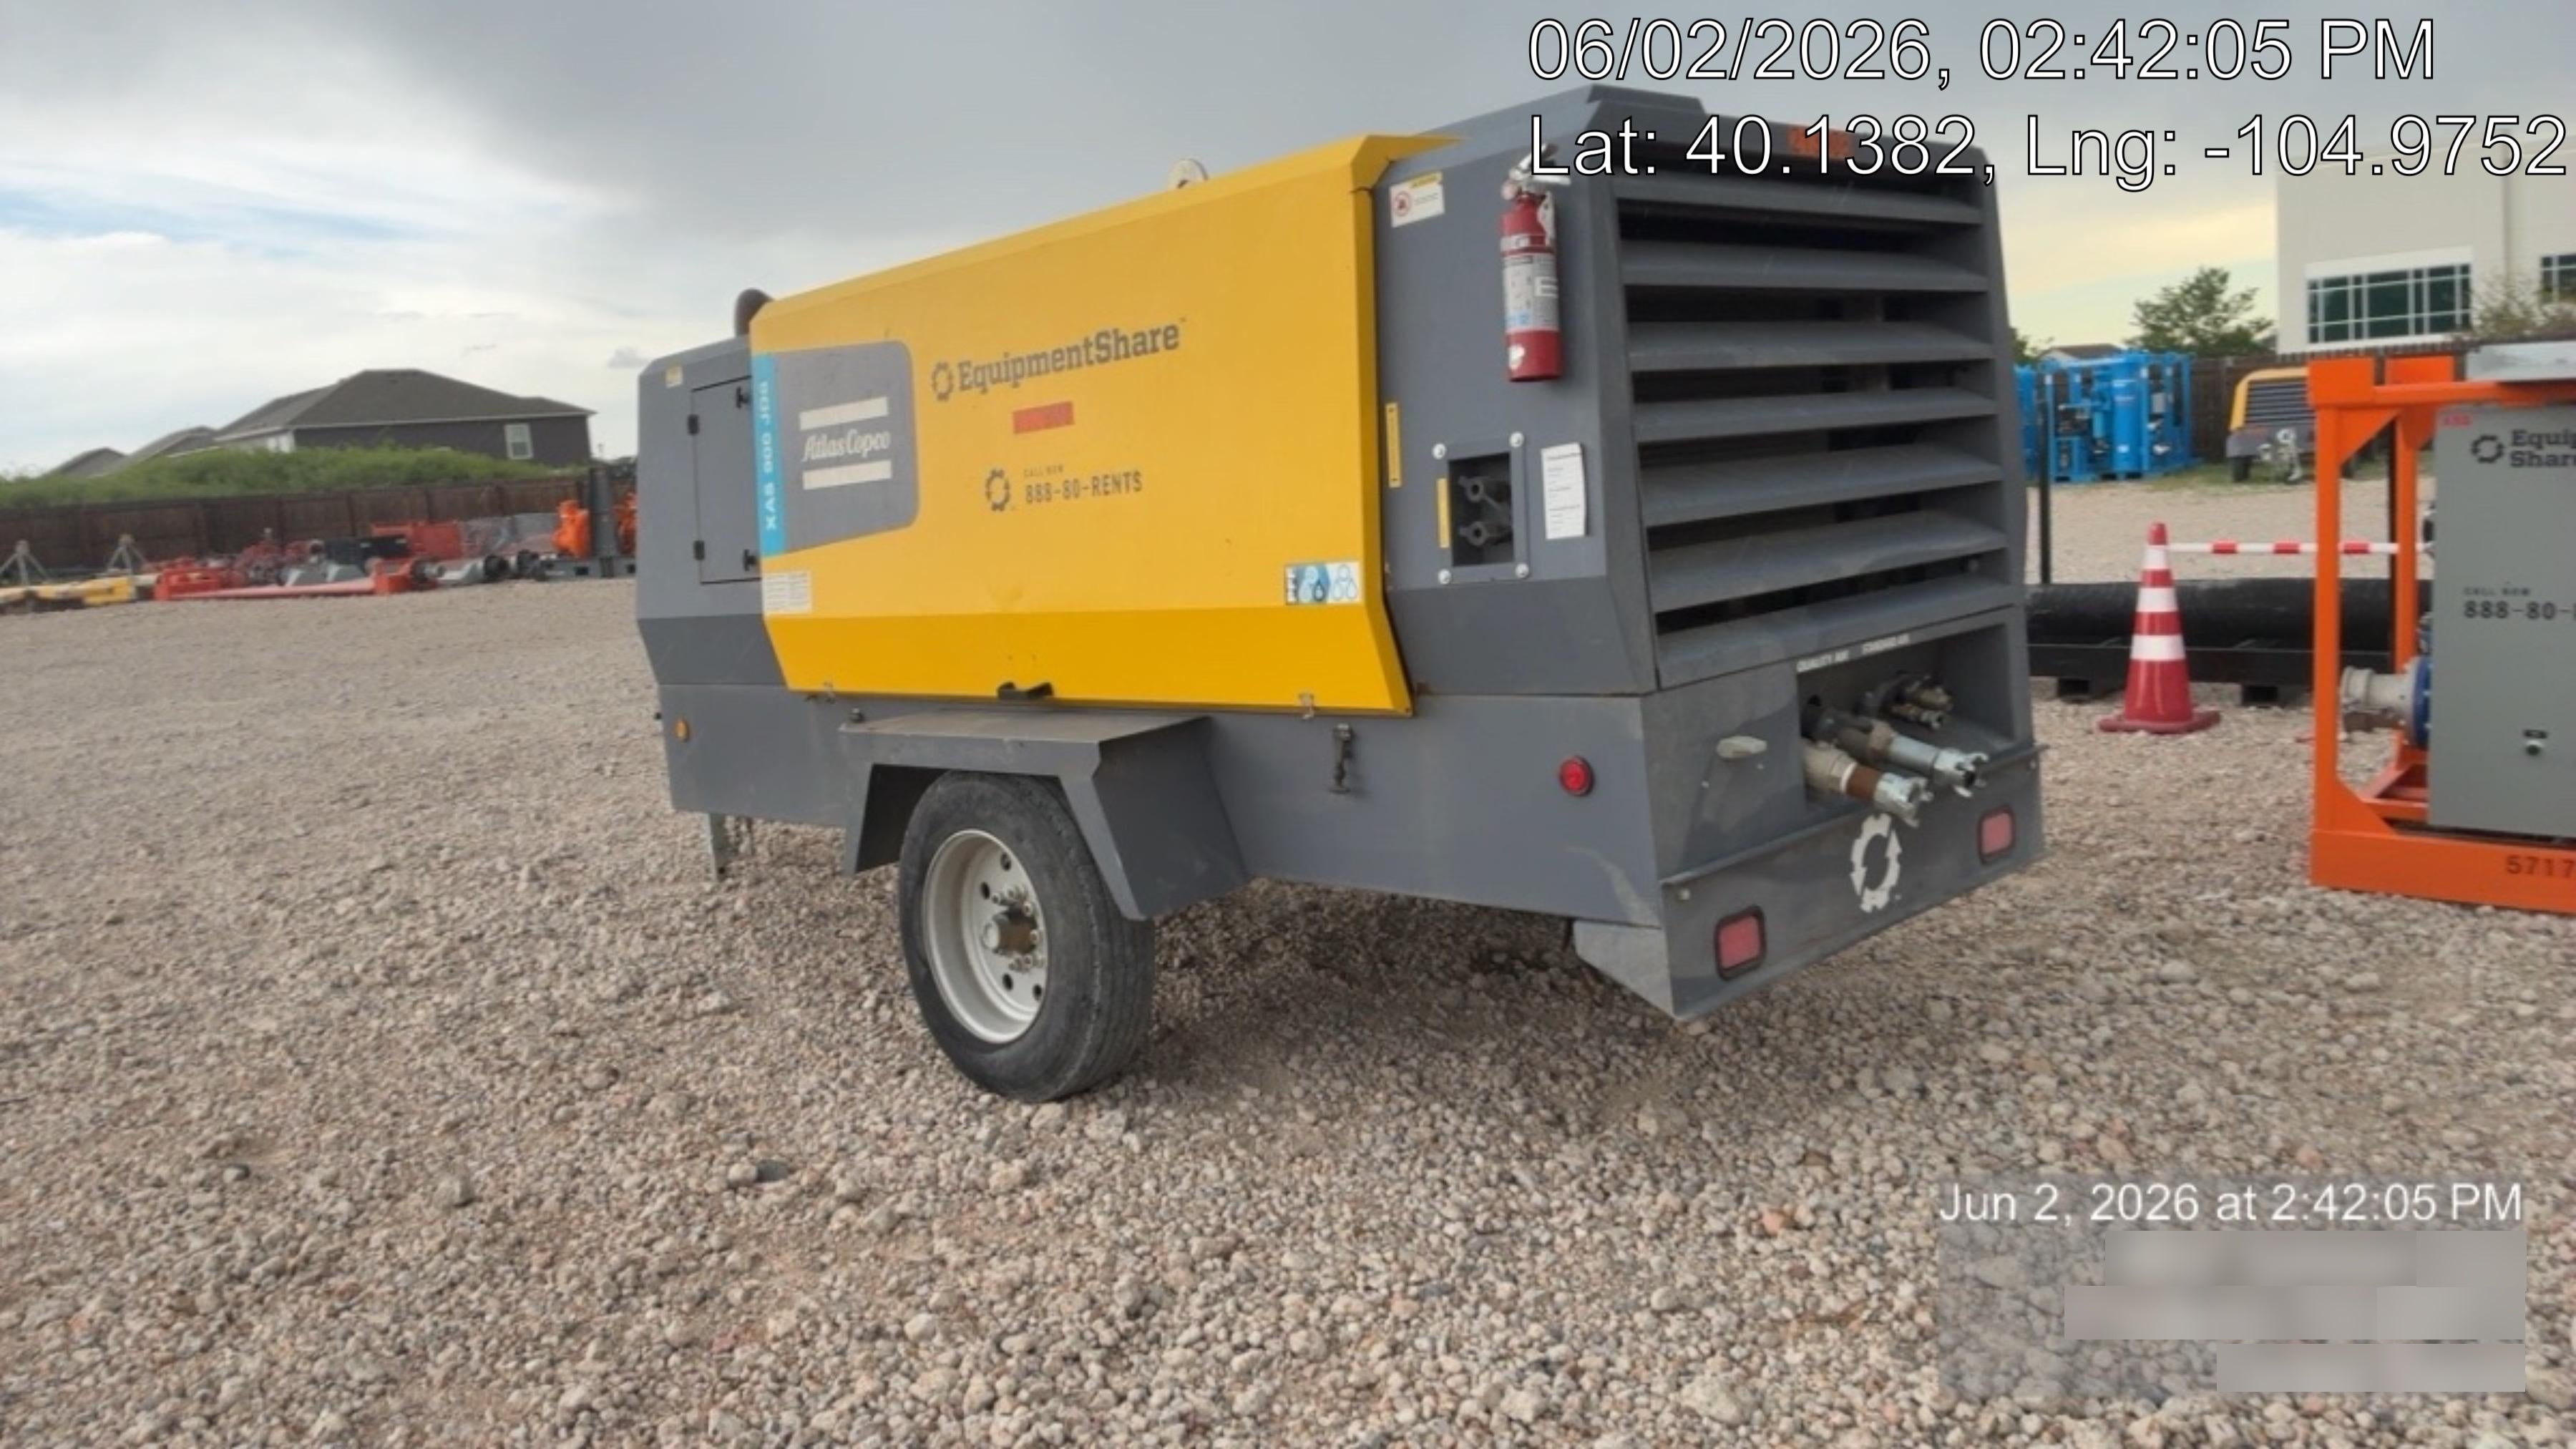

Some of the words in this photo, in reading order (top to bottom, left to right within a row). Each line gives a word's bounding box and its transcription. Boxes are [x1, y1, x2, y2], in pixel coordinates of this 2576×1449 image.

[957, 323, 1179, 394] EquipmentShare
[1025, 469, 1143, 504] 888-80-RENTS
[2464, 600, 2576, 620] 888-80-
